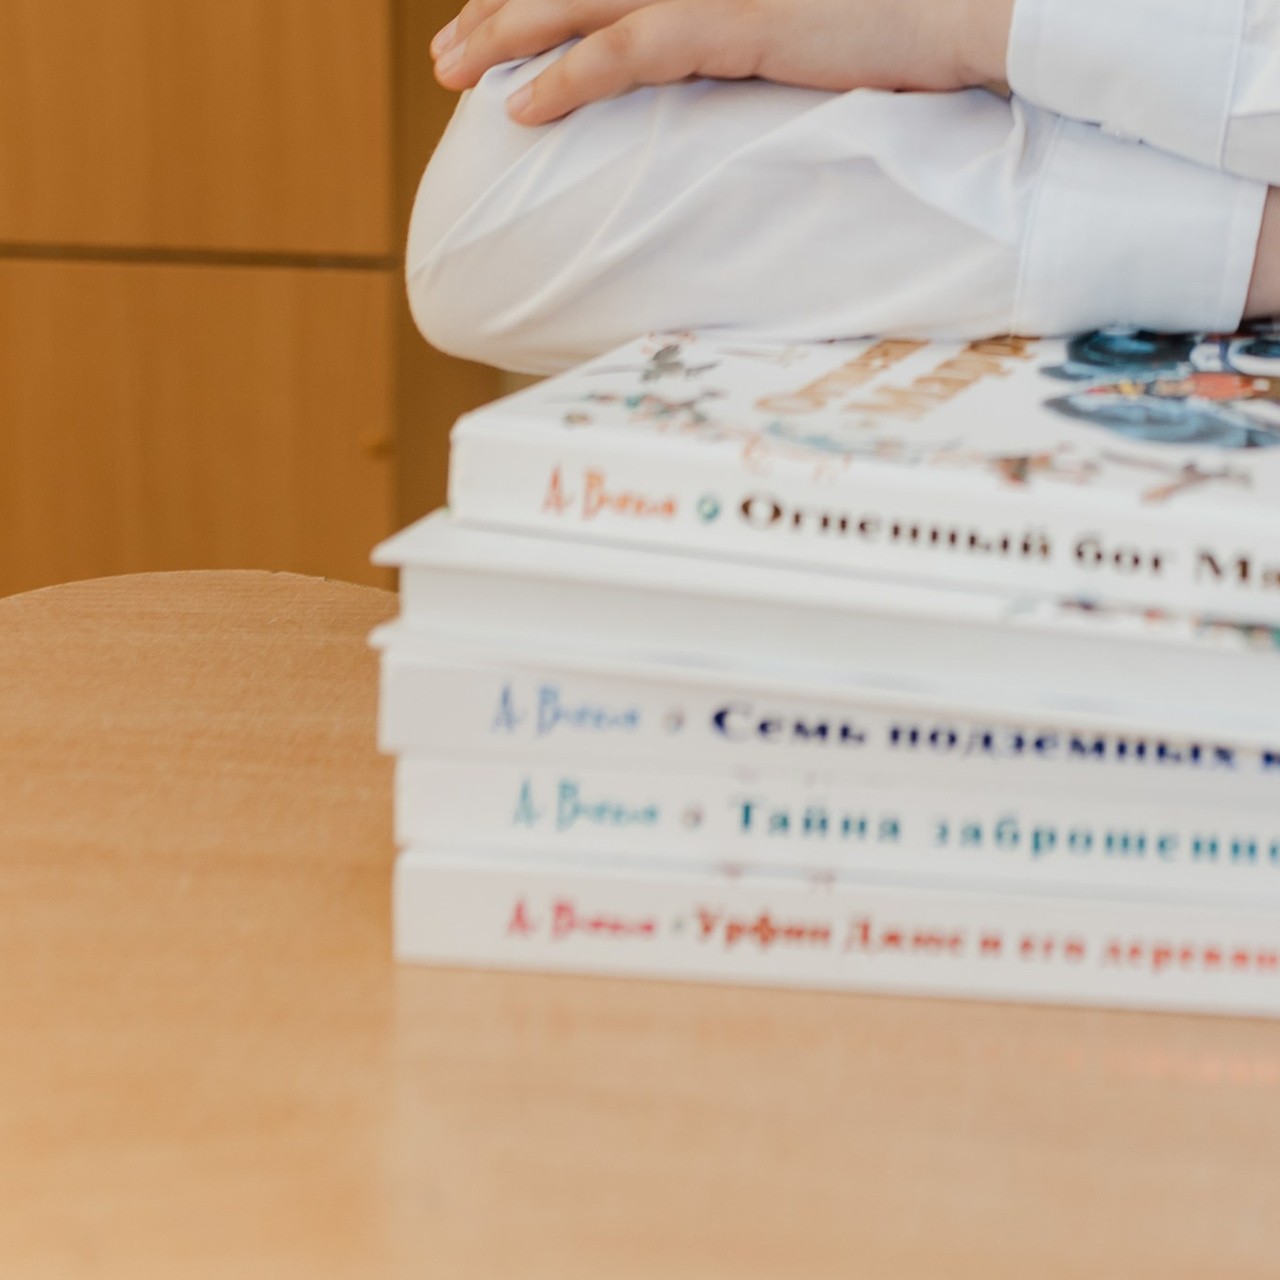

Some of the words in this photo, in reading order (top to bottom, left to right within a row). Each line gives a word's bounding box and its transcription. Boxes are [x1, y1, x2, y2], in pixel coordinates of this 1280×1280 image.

[1071, 538, 1168, 576] бог
[710, 703, 867, 746] Семь
[736, 796, 902, 842] Тайна
